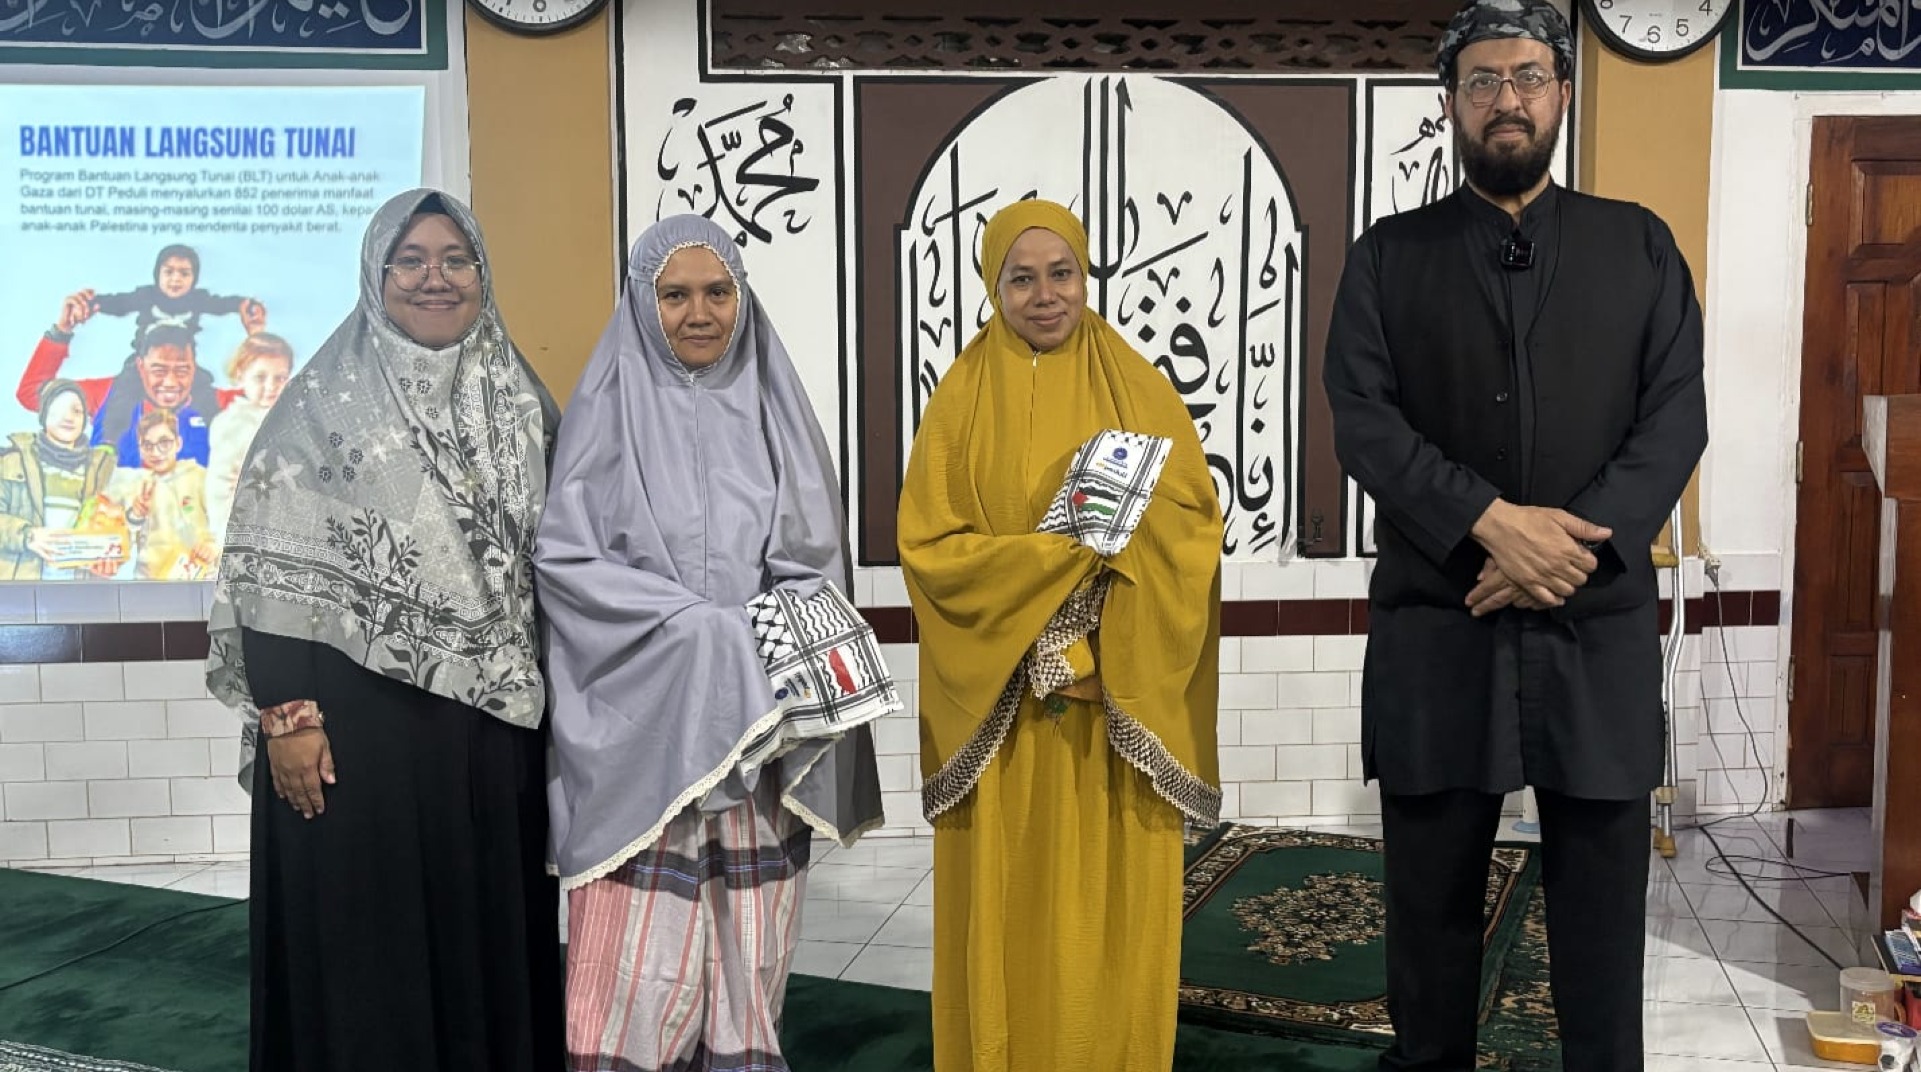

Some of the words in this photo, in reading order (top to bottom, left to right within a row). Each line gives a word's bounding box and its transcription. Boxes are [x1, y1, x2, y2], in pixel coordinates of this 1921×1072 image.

[1619, 14, 1633, 34] 7
[1675, 18, 1689, 37] 5
[1647, 25, 1661, 43] 6
[20, 125, 136, 157] BANTUAN
[144, 126, 275, 158] LANGSUNG
[284, 127, 356, 158] TUNAI
[20, 169, 75, 184] Program
[78, 169, 132, 182] Bantuan
[134, 170, 197, 185] Langsung
[201, 170, 235, 182] Tunai
[238, 170, 273, 184] (BLT)
[276, 171, 309, 183] untuk
[312, 171, 380, 183] Anak-anak
[20, 186, 55, 199] Gaza
[58, 186, 82, 199] dari
[85, 186, 105, 199] DT
[108, 186, 148, 199] Peduli
[151, 187, 231, 201] menyalurkan
[234, 187, 258, 200] 852
[261, 187, 320, 201] penerima
[323, 187, 374, 200] manfaat
[20, 203, 72, 216] bantuan
[75, 203, 110, 217] tunai,
[113, 203, 208, 219] masing-masing
[213, 203, 252, 216] senilai
[257, 203, 278, 216] 100
[281, 203, 312, 216] dolar
[21, 219, 86, 232] anak-anak
[90, 219, 148, 232] Palestina
[151, 221, 183, 235] yang
[187, 220, 248, 233] menderita
[251, 220, 304, 235] penyakit
[306, 220, 342, 233] berat.
